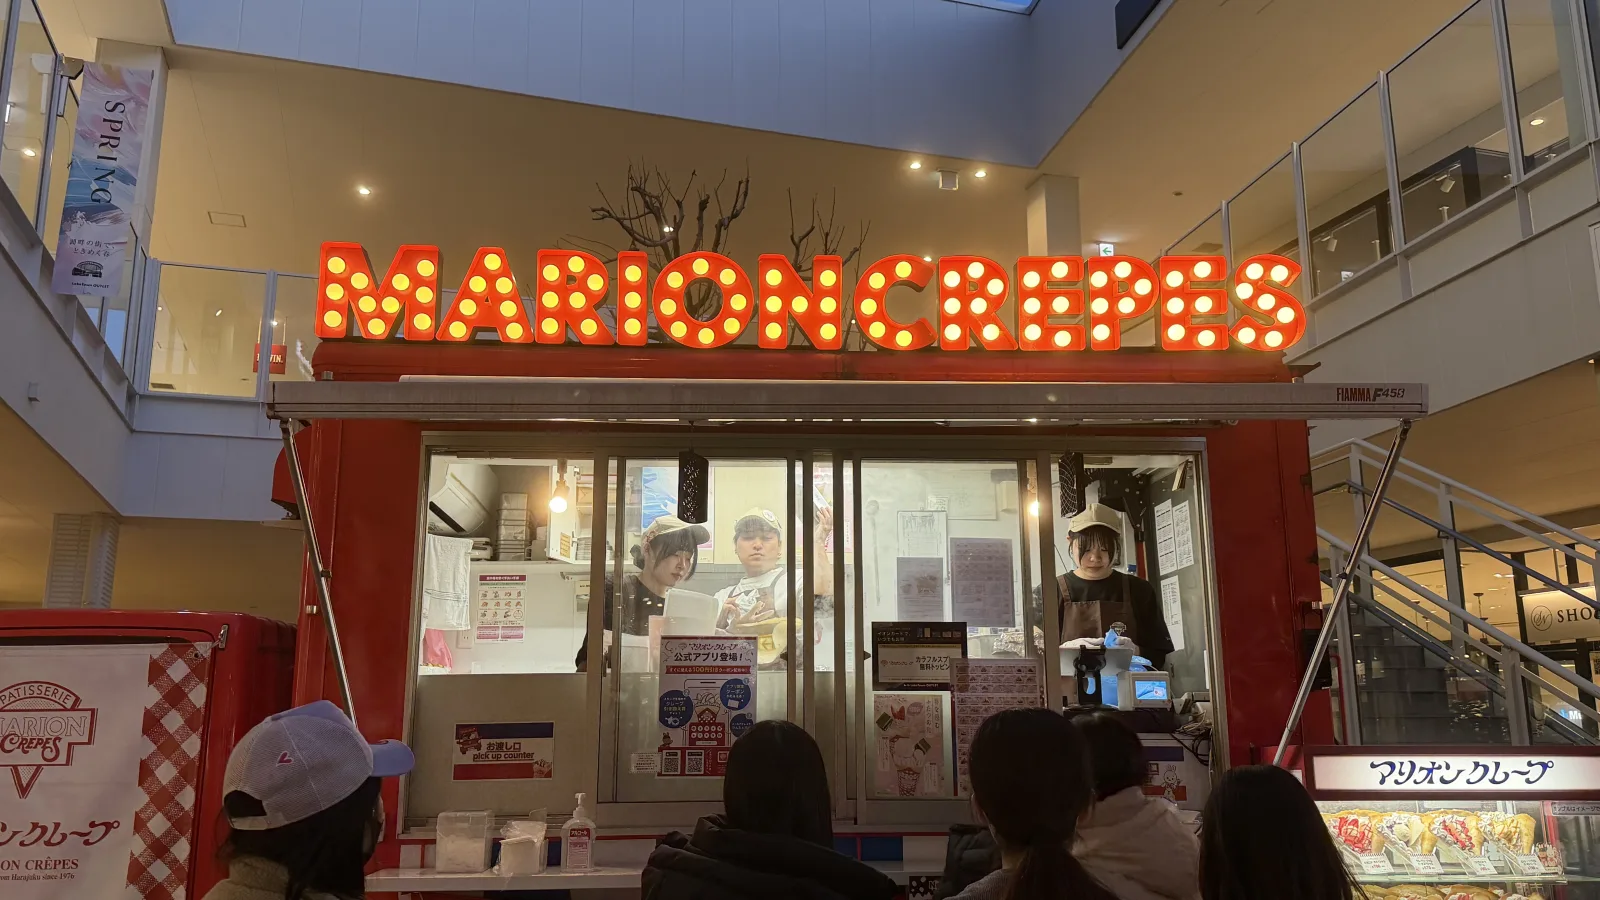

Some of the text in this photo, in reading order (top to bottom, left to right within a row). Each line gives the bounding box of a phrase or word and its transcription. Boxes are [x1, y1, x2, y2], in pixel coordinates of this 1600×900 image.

[90, 100, 126, 205] SPRING
[1336, 388, 1371, 402] FIAMMA
[0, 684, 72, 704] PATISSERIE
[486, 741, 522, 751] お渡し口
[472, 751, 535, 762] pick up counter
[1369, 760, 1555, 786] マリオンクレープ
[25, 856, 79, 871] CRÊPES
[11, 874, 41, 882] Harajuku
[42, 873, 58, 881] since
[60, 872, 75, 880] 1976
